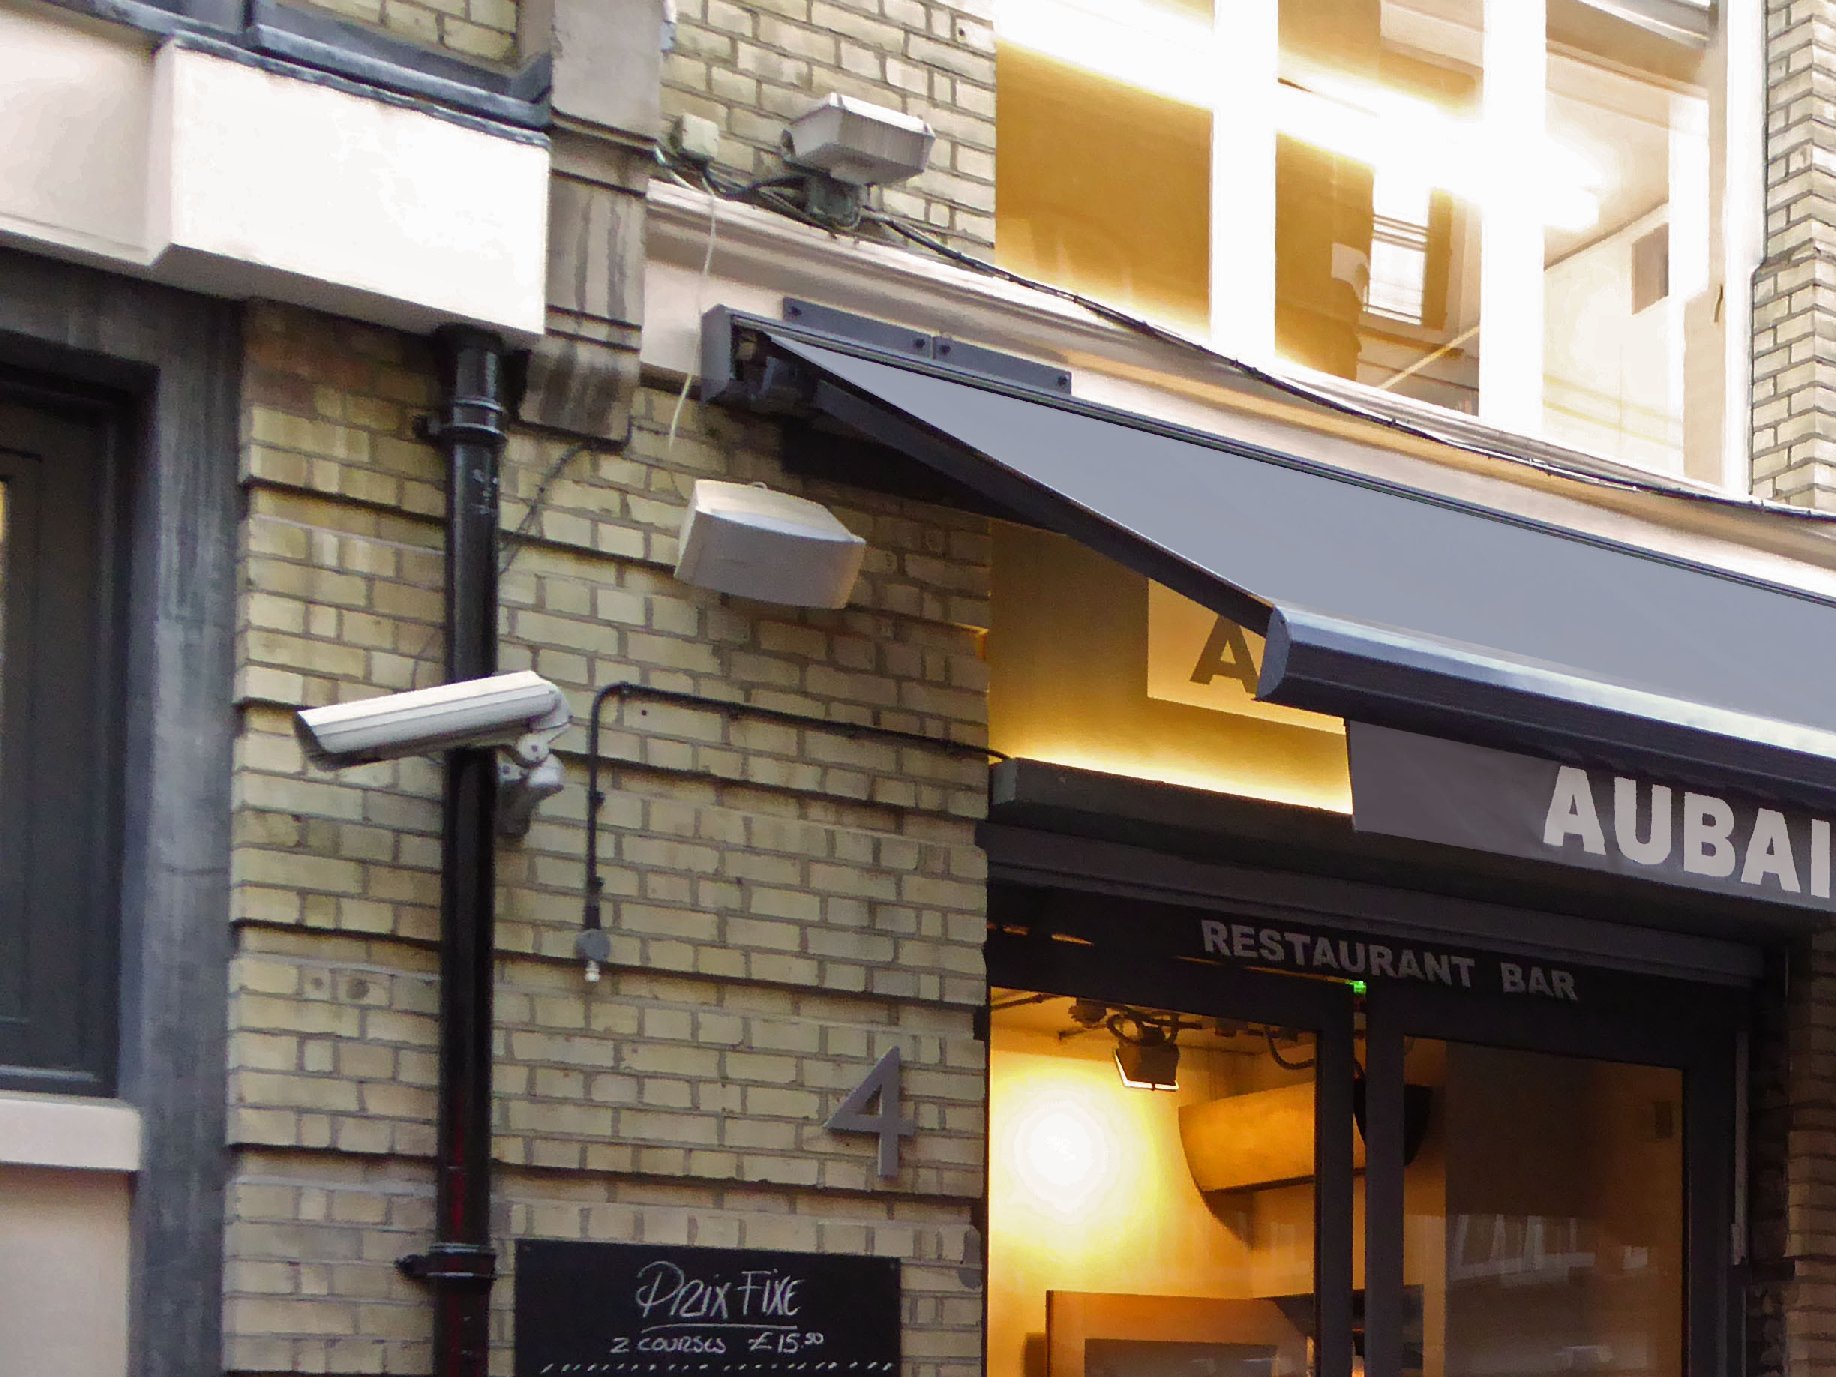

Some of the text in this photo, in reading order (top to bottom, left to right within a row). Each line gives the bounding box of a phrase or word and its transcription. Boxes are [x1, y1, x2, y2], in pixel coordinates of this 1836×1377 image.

[1201, 919, 1579, 1001] RESTAURANT BAR
[822, 1045, 917, 1176] 4
[610, 1338, 629, 1353] 2
[638, 1337, 726, 1353] COURSES
